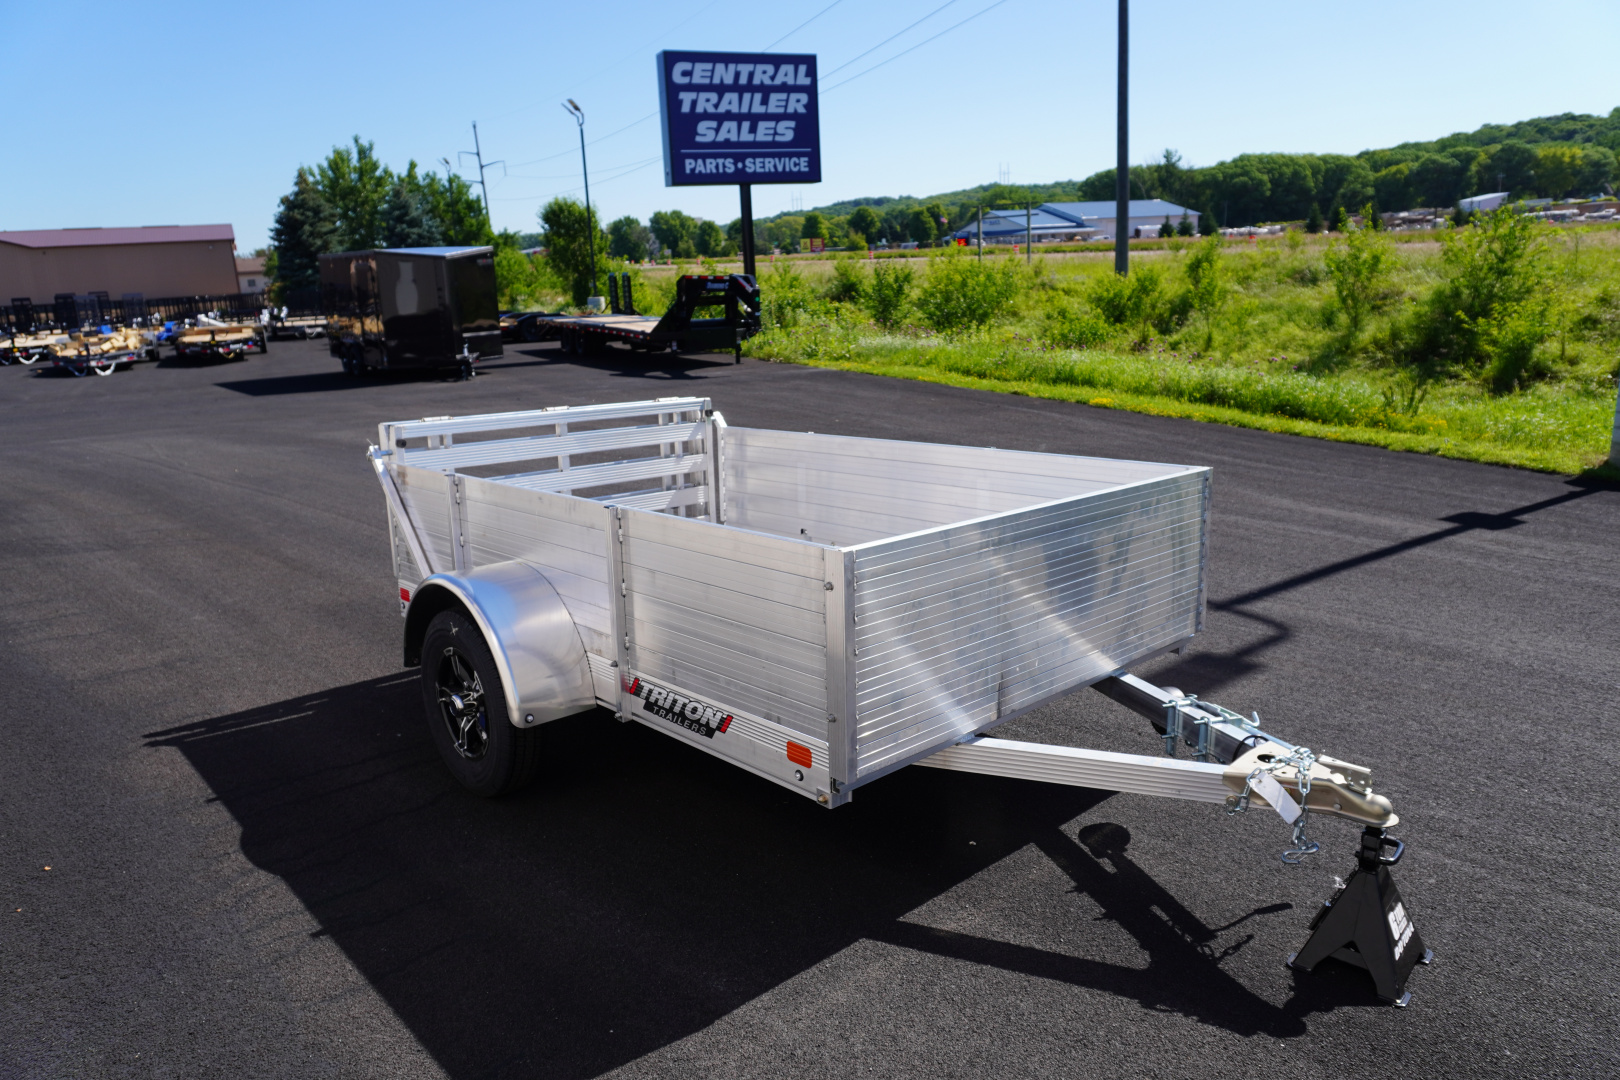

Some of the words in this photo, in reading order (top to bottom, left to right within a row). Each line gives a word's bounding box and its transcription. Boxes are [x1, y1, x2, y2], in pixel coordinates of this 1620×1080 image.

[671, 61, 812, 85] CENTRAL
[678, 91, 809, 114] TRAILER
[694, 120, 797, 143] SALES
[684, 158, 735, 174] PARTS
[745, 157, 809, 173] SERVICE
[638, 679, 724, 730] TRITON
[651, 706, 707, 736] TRAILERS
